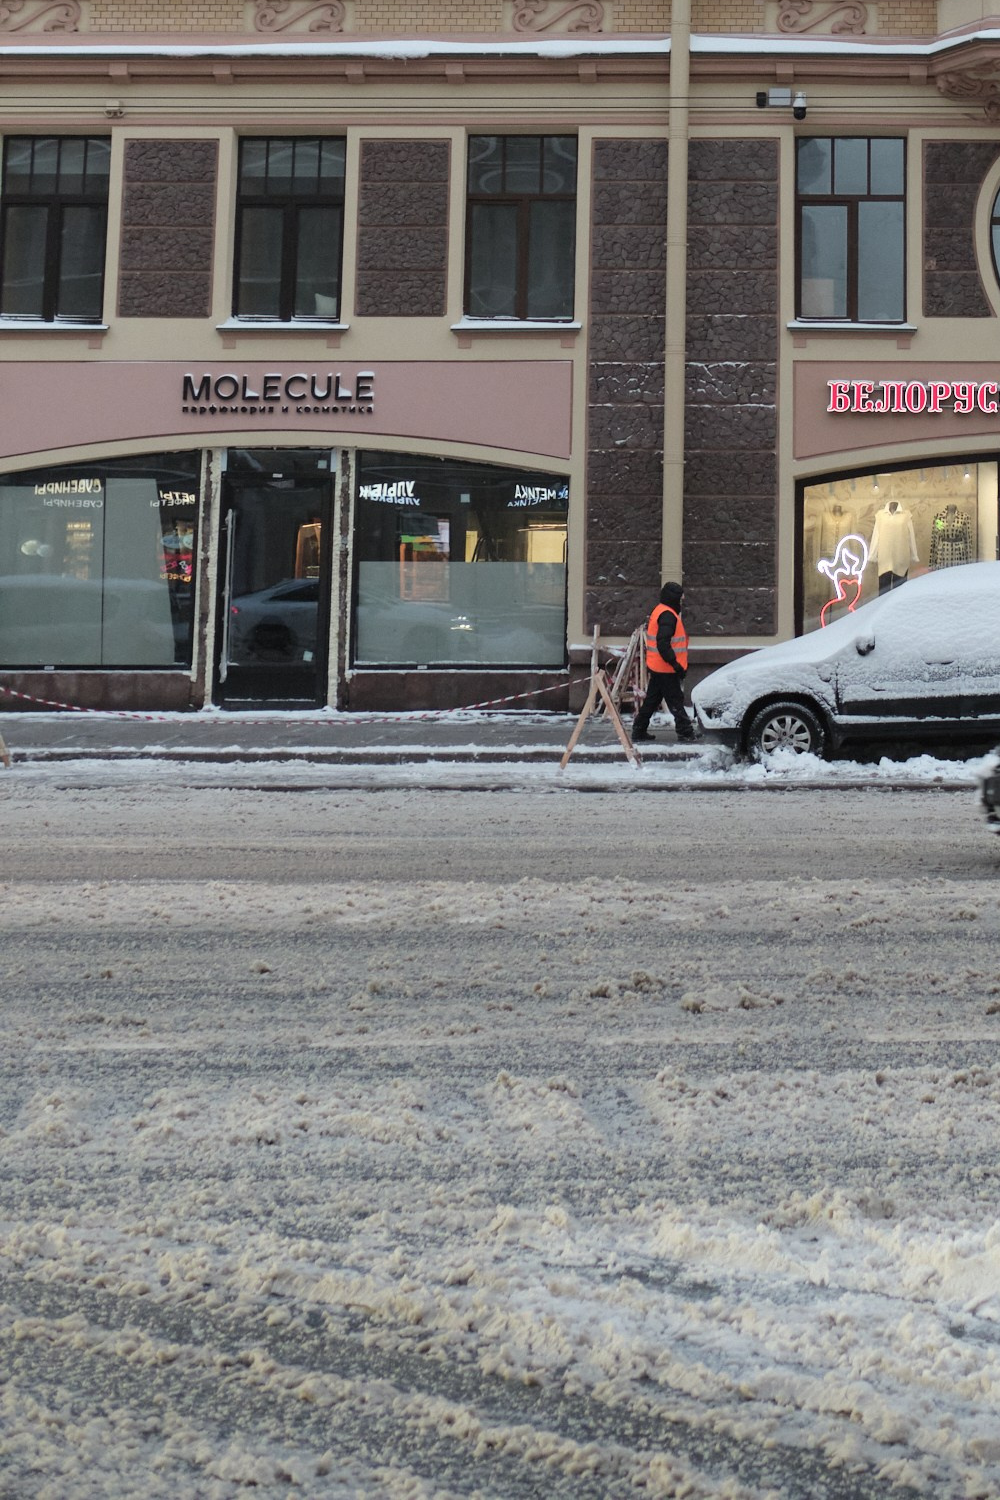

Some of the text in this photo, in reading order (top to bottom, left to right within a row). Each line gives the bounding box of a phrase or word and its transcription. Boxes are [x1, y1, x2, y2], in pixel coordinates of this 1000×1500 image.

[182, 373, 375, 401] MOLECULE
[182, 404, 374, 415] парфюмерия и косметика
